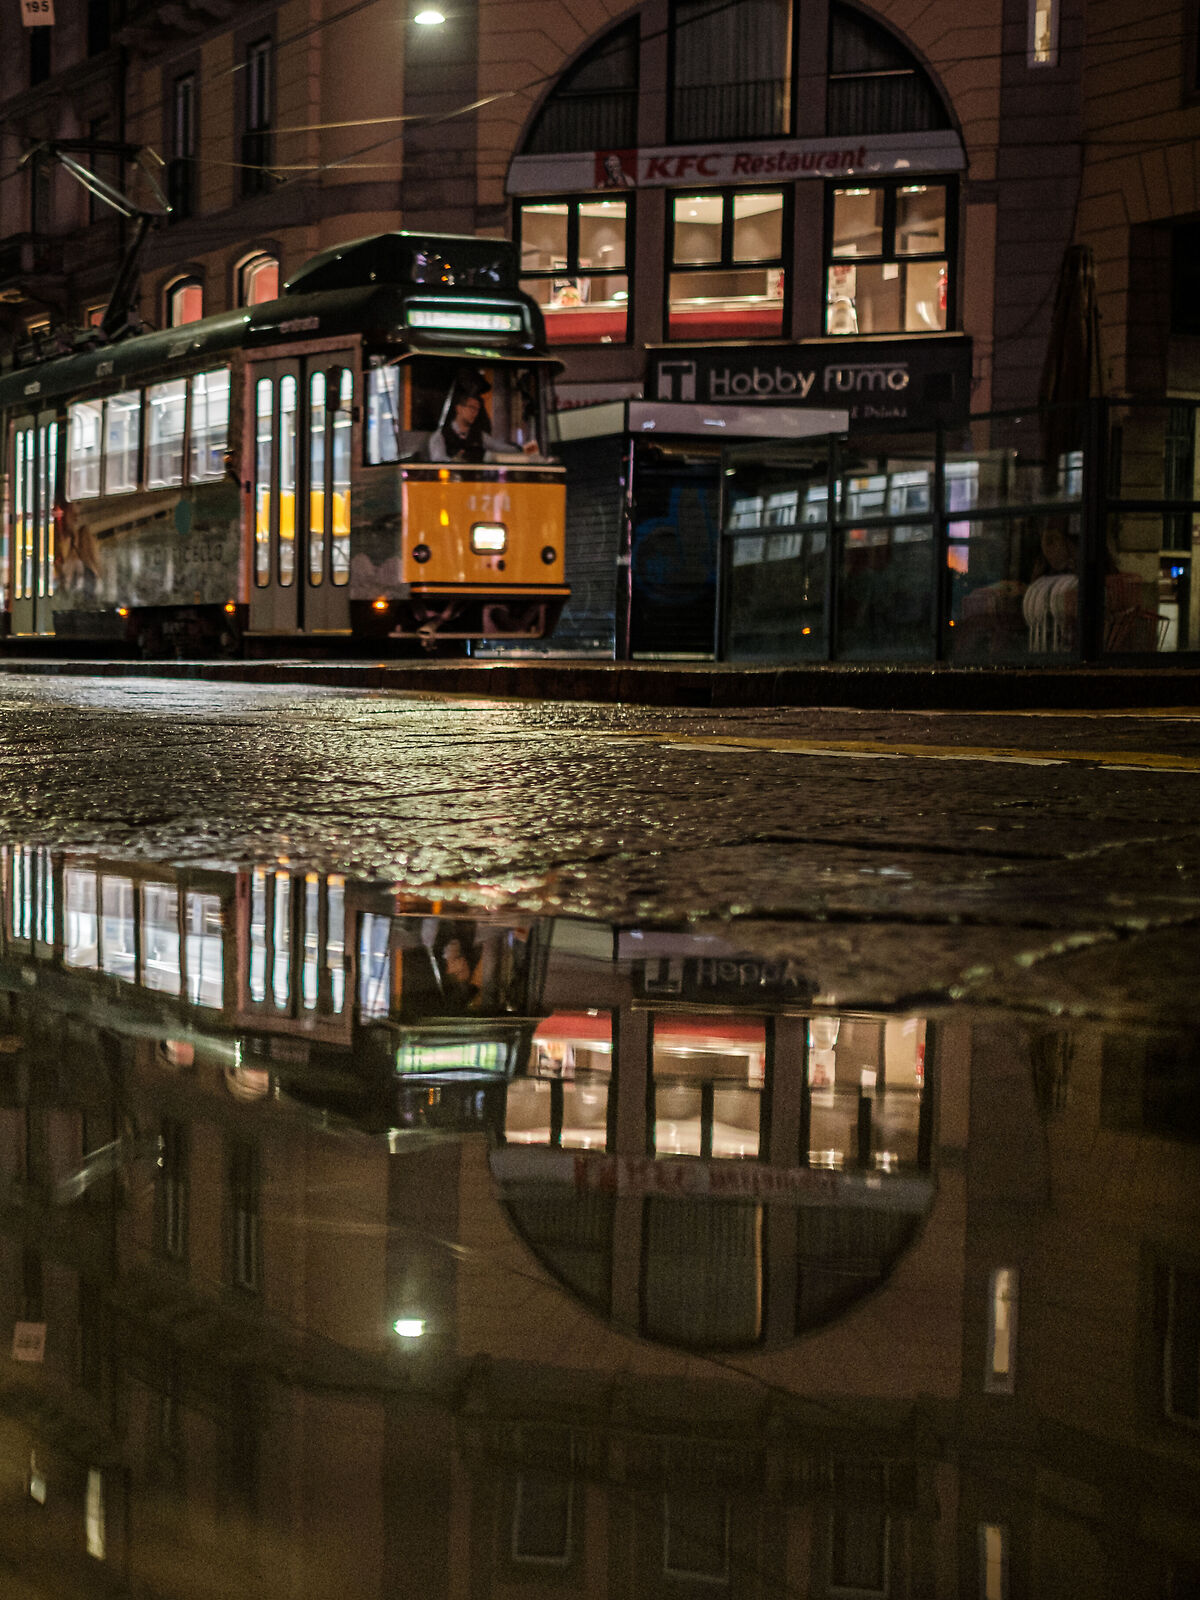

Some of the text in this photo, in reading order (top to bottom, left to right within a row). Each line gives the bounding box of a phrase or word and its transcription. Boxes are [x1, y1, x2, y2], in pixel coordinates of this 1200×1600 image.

[25, 0, 49, 13] 195
[644, 146, 867, 179] KFC Restaurant
[709, 366, 815, 399] Hobby
